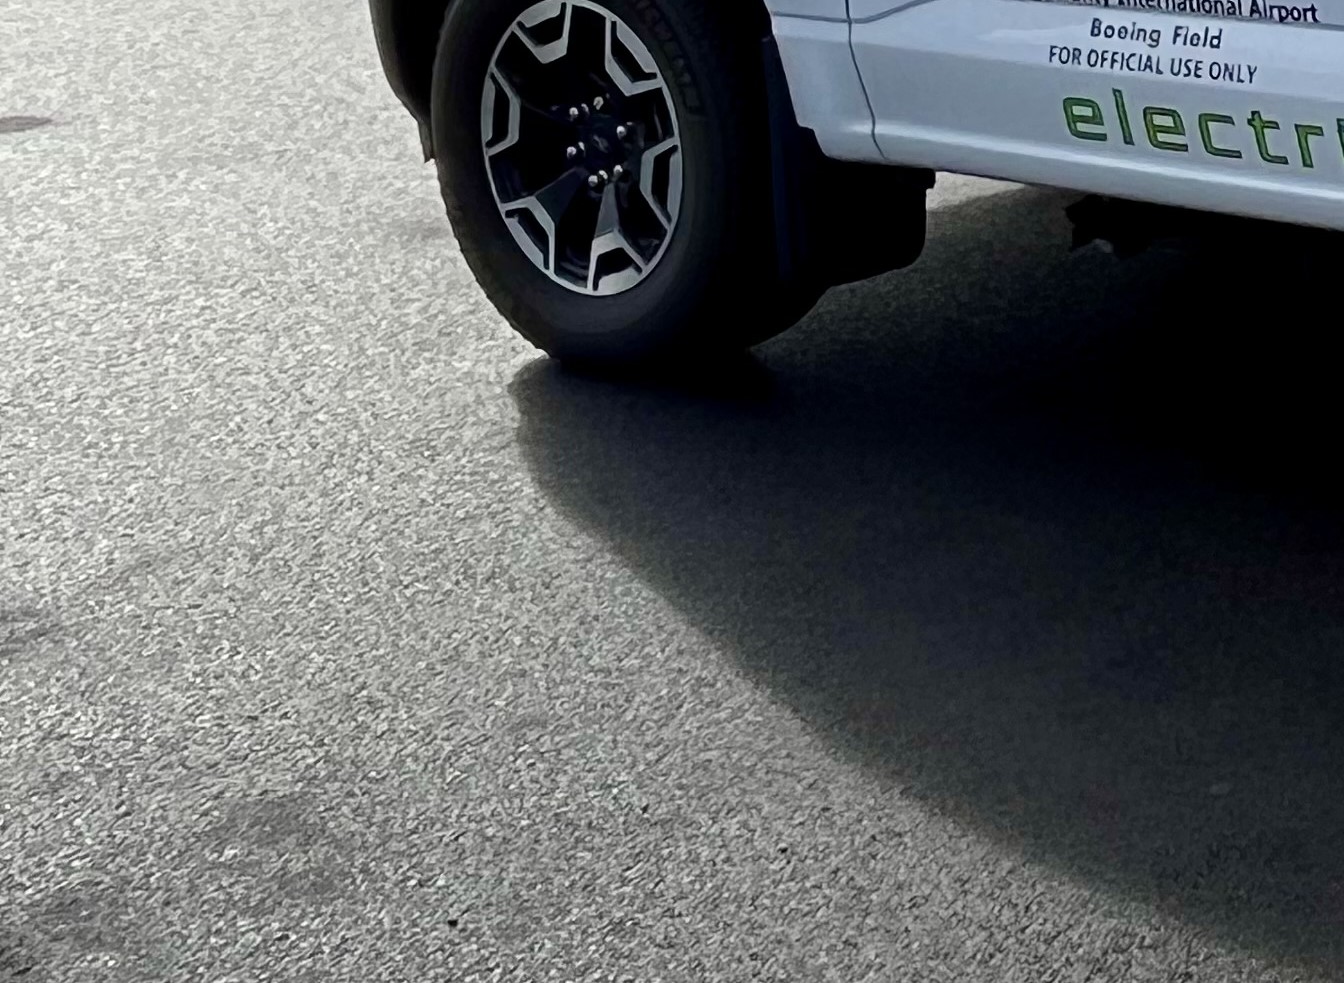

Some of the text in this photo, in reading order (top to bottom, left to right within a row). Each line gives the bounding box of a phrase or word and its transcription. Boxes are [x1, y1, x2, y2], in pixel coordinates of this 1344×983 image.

[1090, 18, 1223, 49] Boeing Field
[1049, 45, 1258, 84] FOR OFFICIAL USE ONLY
